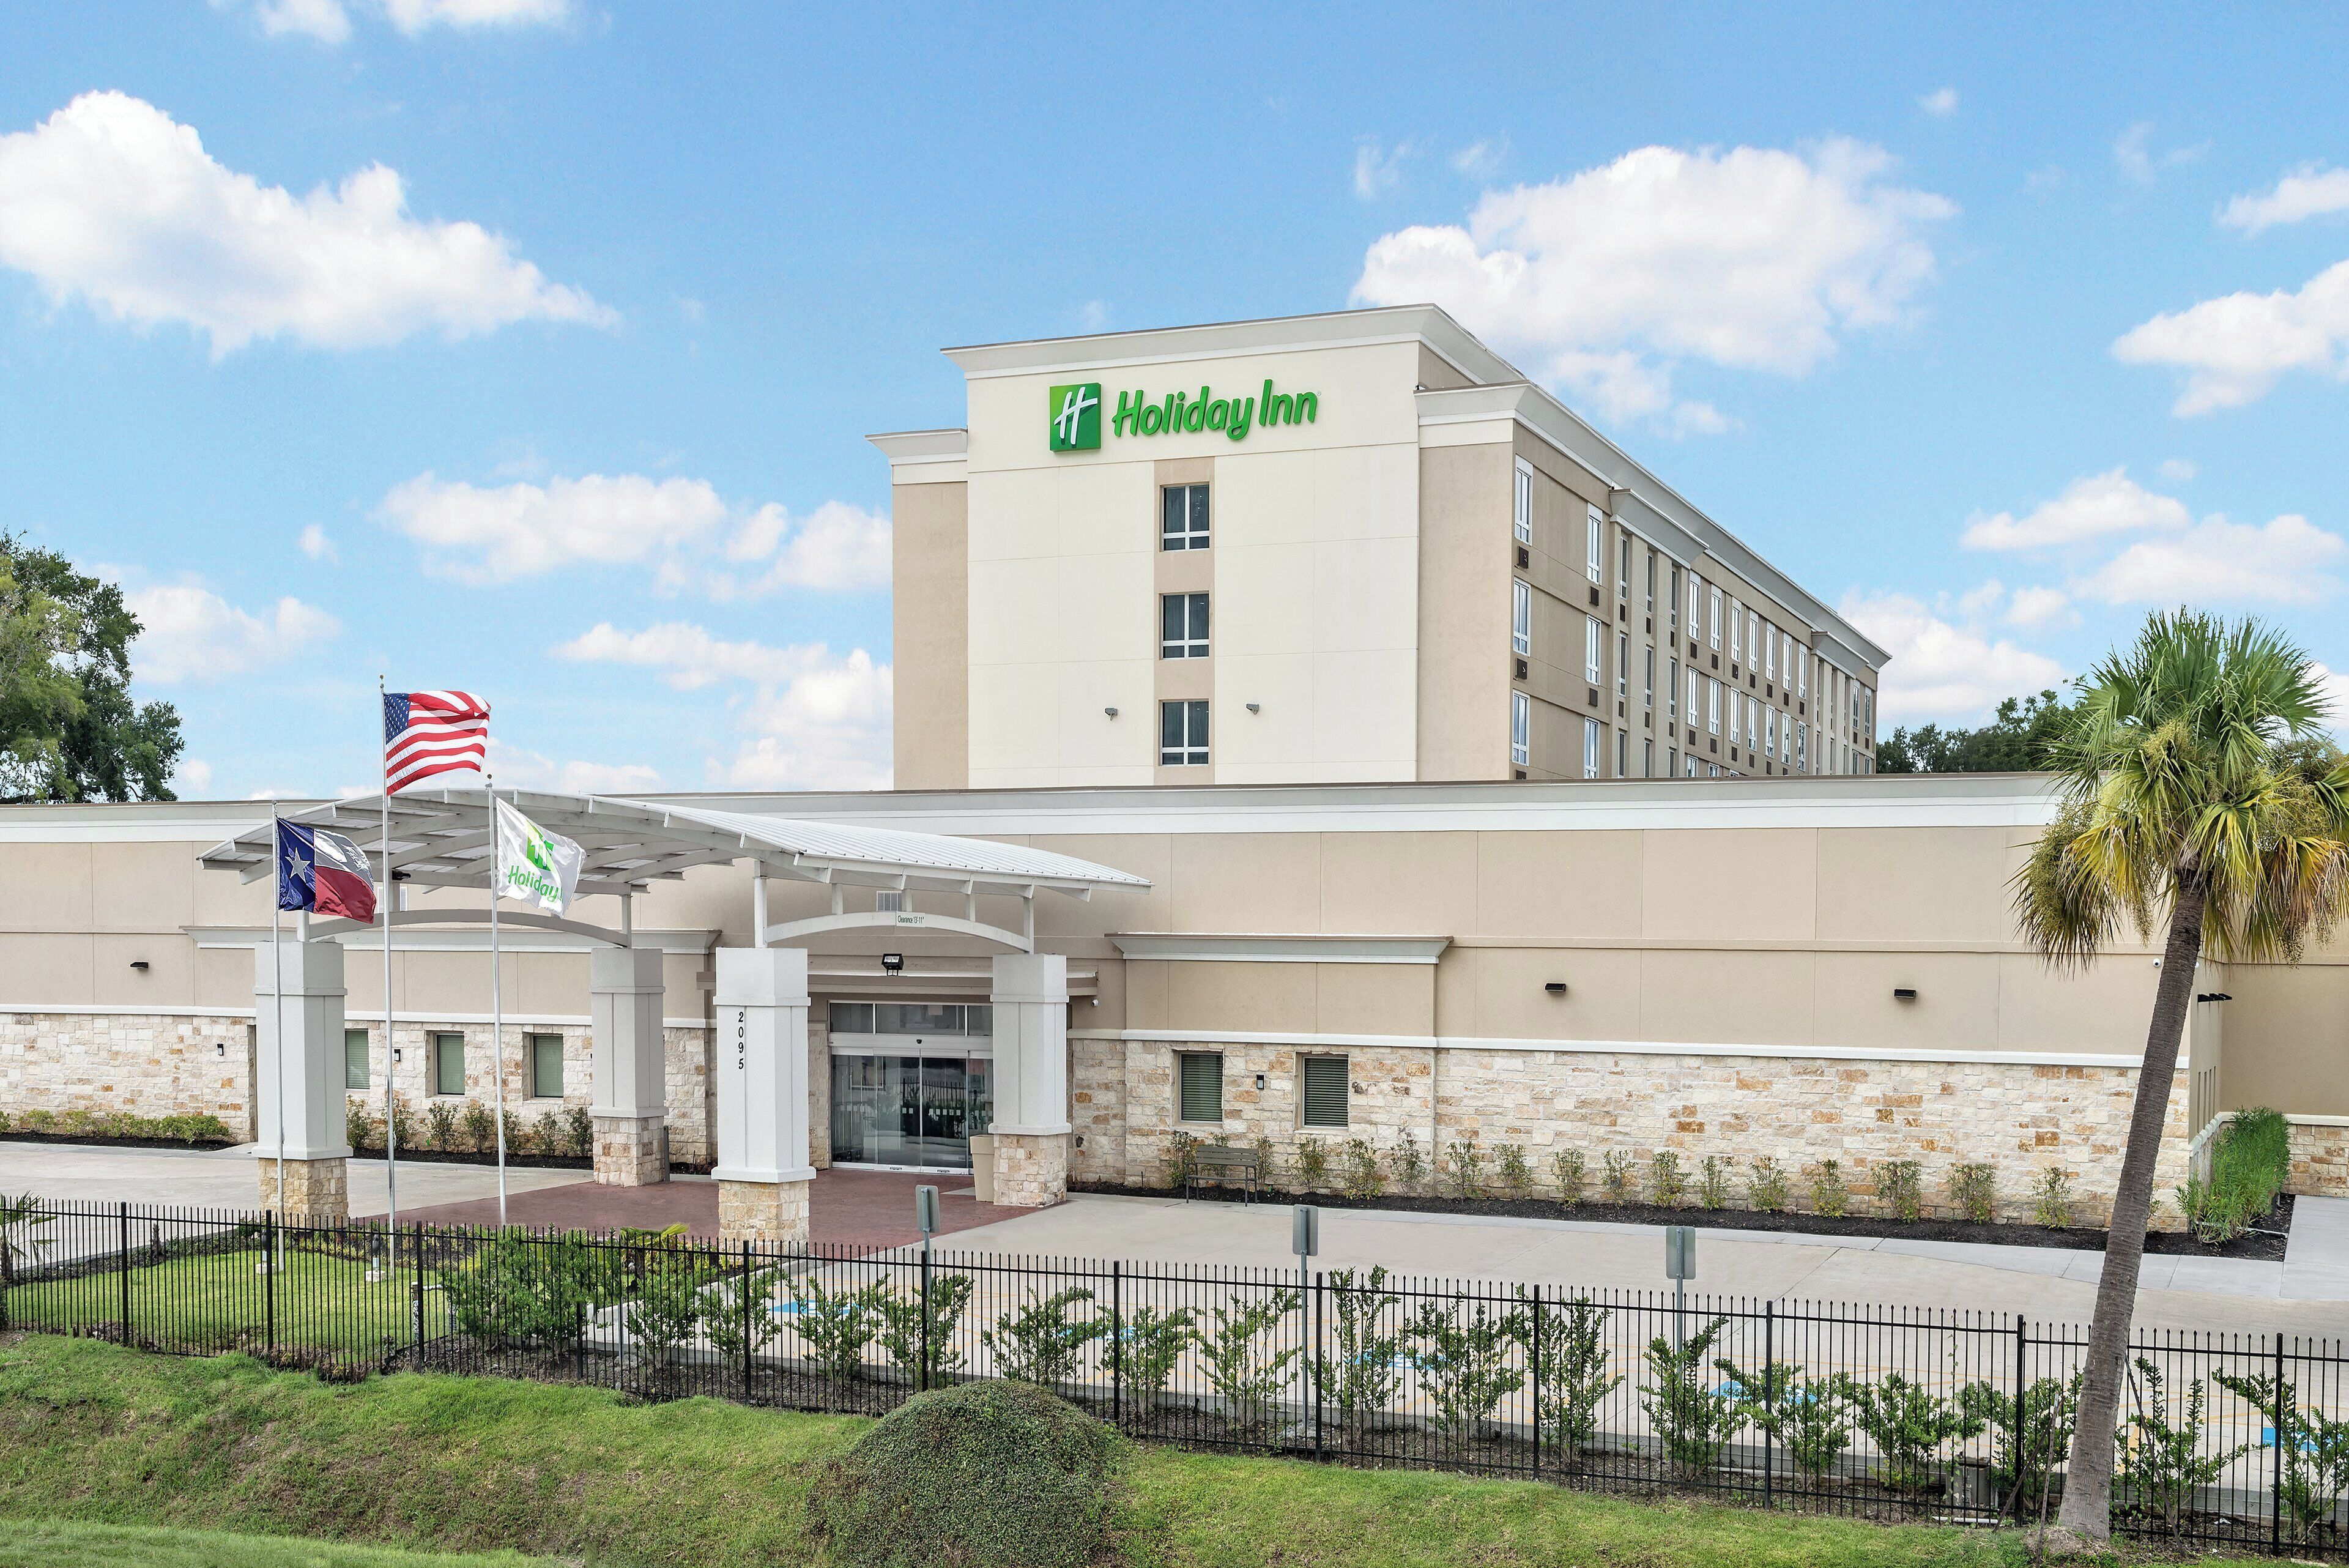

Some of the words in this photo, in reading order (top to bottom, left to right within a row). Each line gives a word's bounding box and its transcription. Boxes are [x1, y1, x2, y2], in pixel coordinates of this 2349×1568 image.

[1111, 385, 1254, 440] Holiday
[1258, 379, 1318, 426] Inn
[508, 865, 558, 902] Holiday
[897, 915, 913, 923] Clearance
